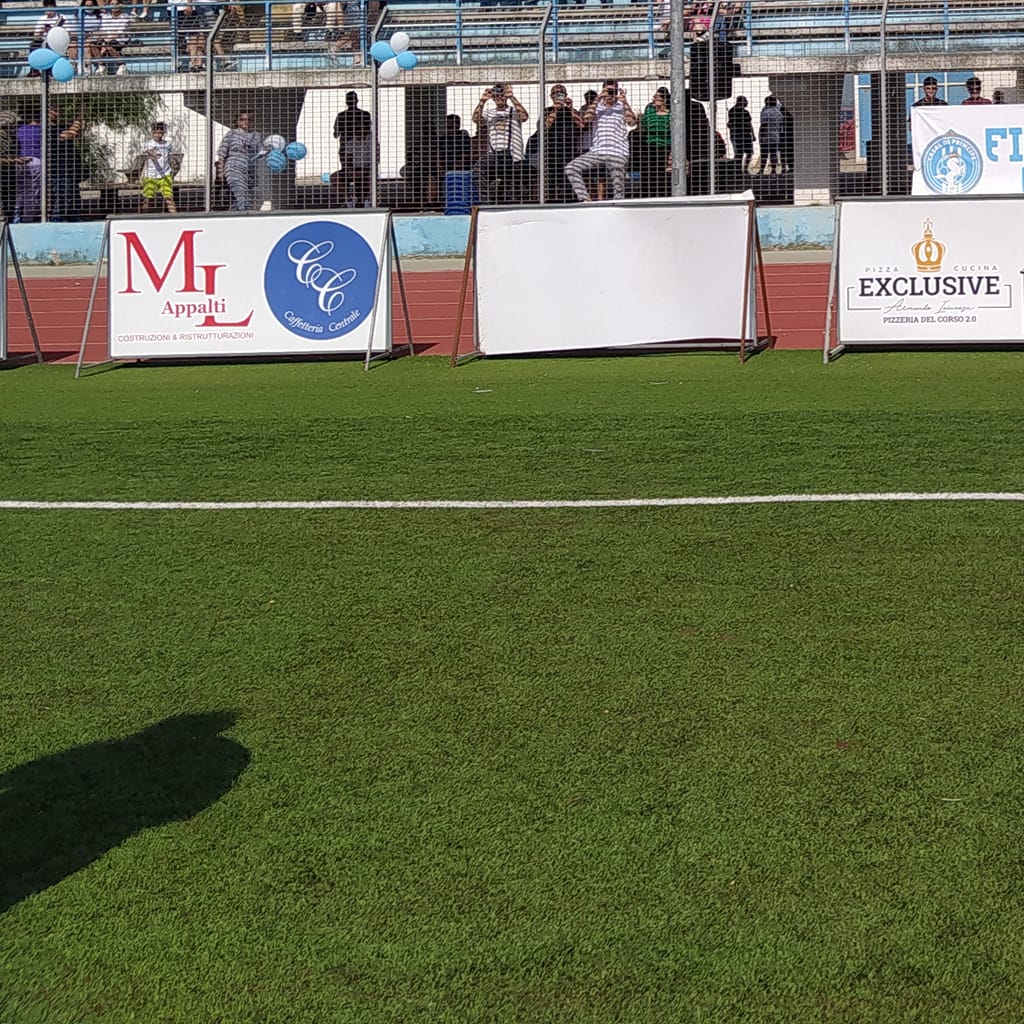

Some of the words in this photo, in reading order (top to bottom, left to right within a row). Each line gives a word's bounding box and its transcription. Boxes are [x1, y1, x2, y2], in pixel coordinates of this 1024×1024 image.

[943, 138, 951, 146] DI
[859, 276, 1000, 297] EXCLUSIVE
[161, 298, 226, 318] Appalti
[284, 310, 324, 333] Caffetteria
[328, 309, 361, 332] Centrale
[883, 316, 919, 324] PIZZERIA
[118, 334, 171, 343] COSTRUZIONI
[179, 332, 254, 341] RISTRUTTURAZIONI
